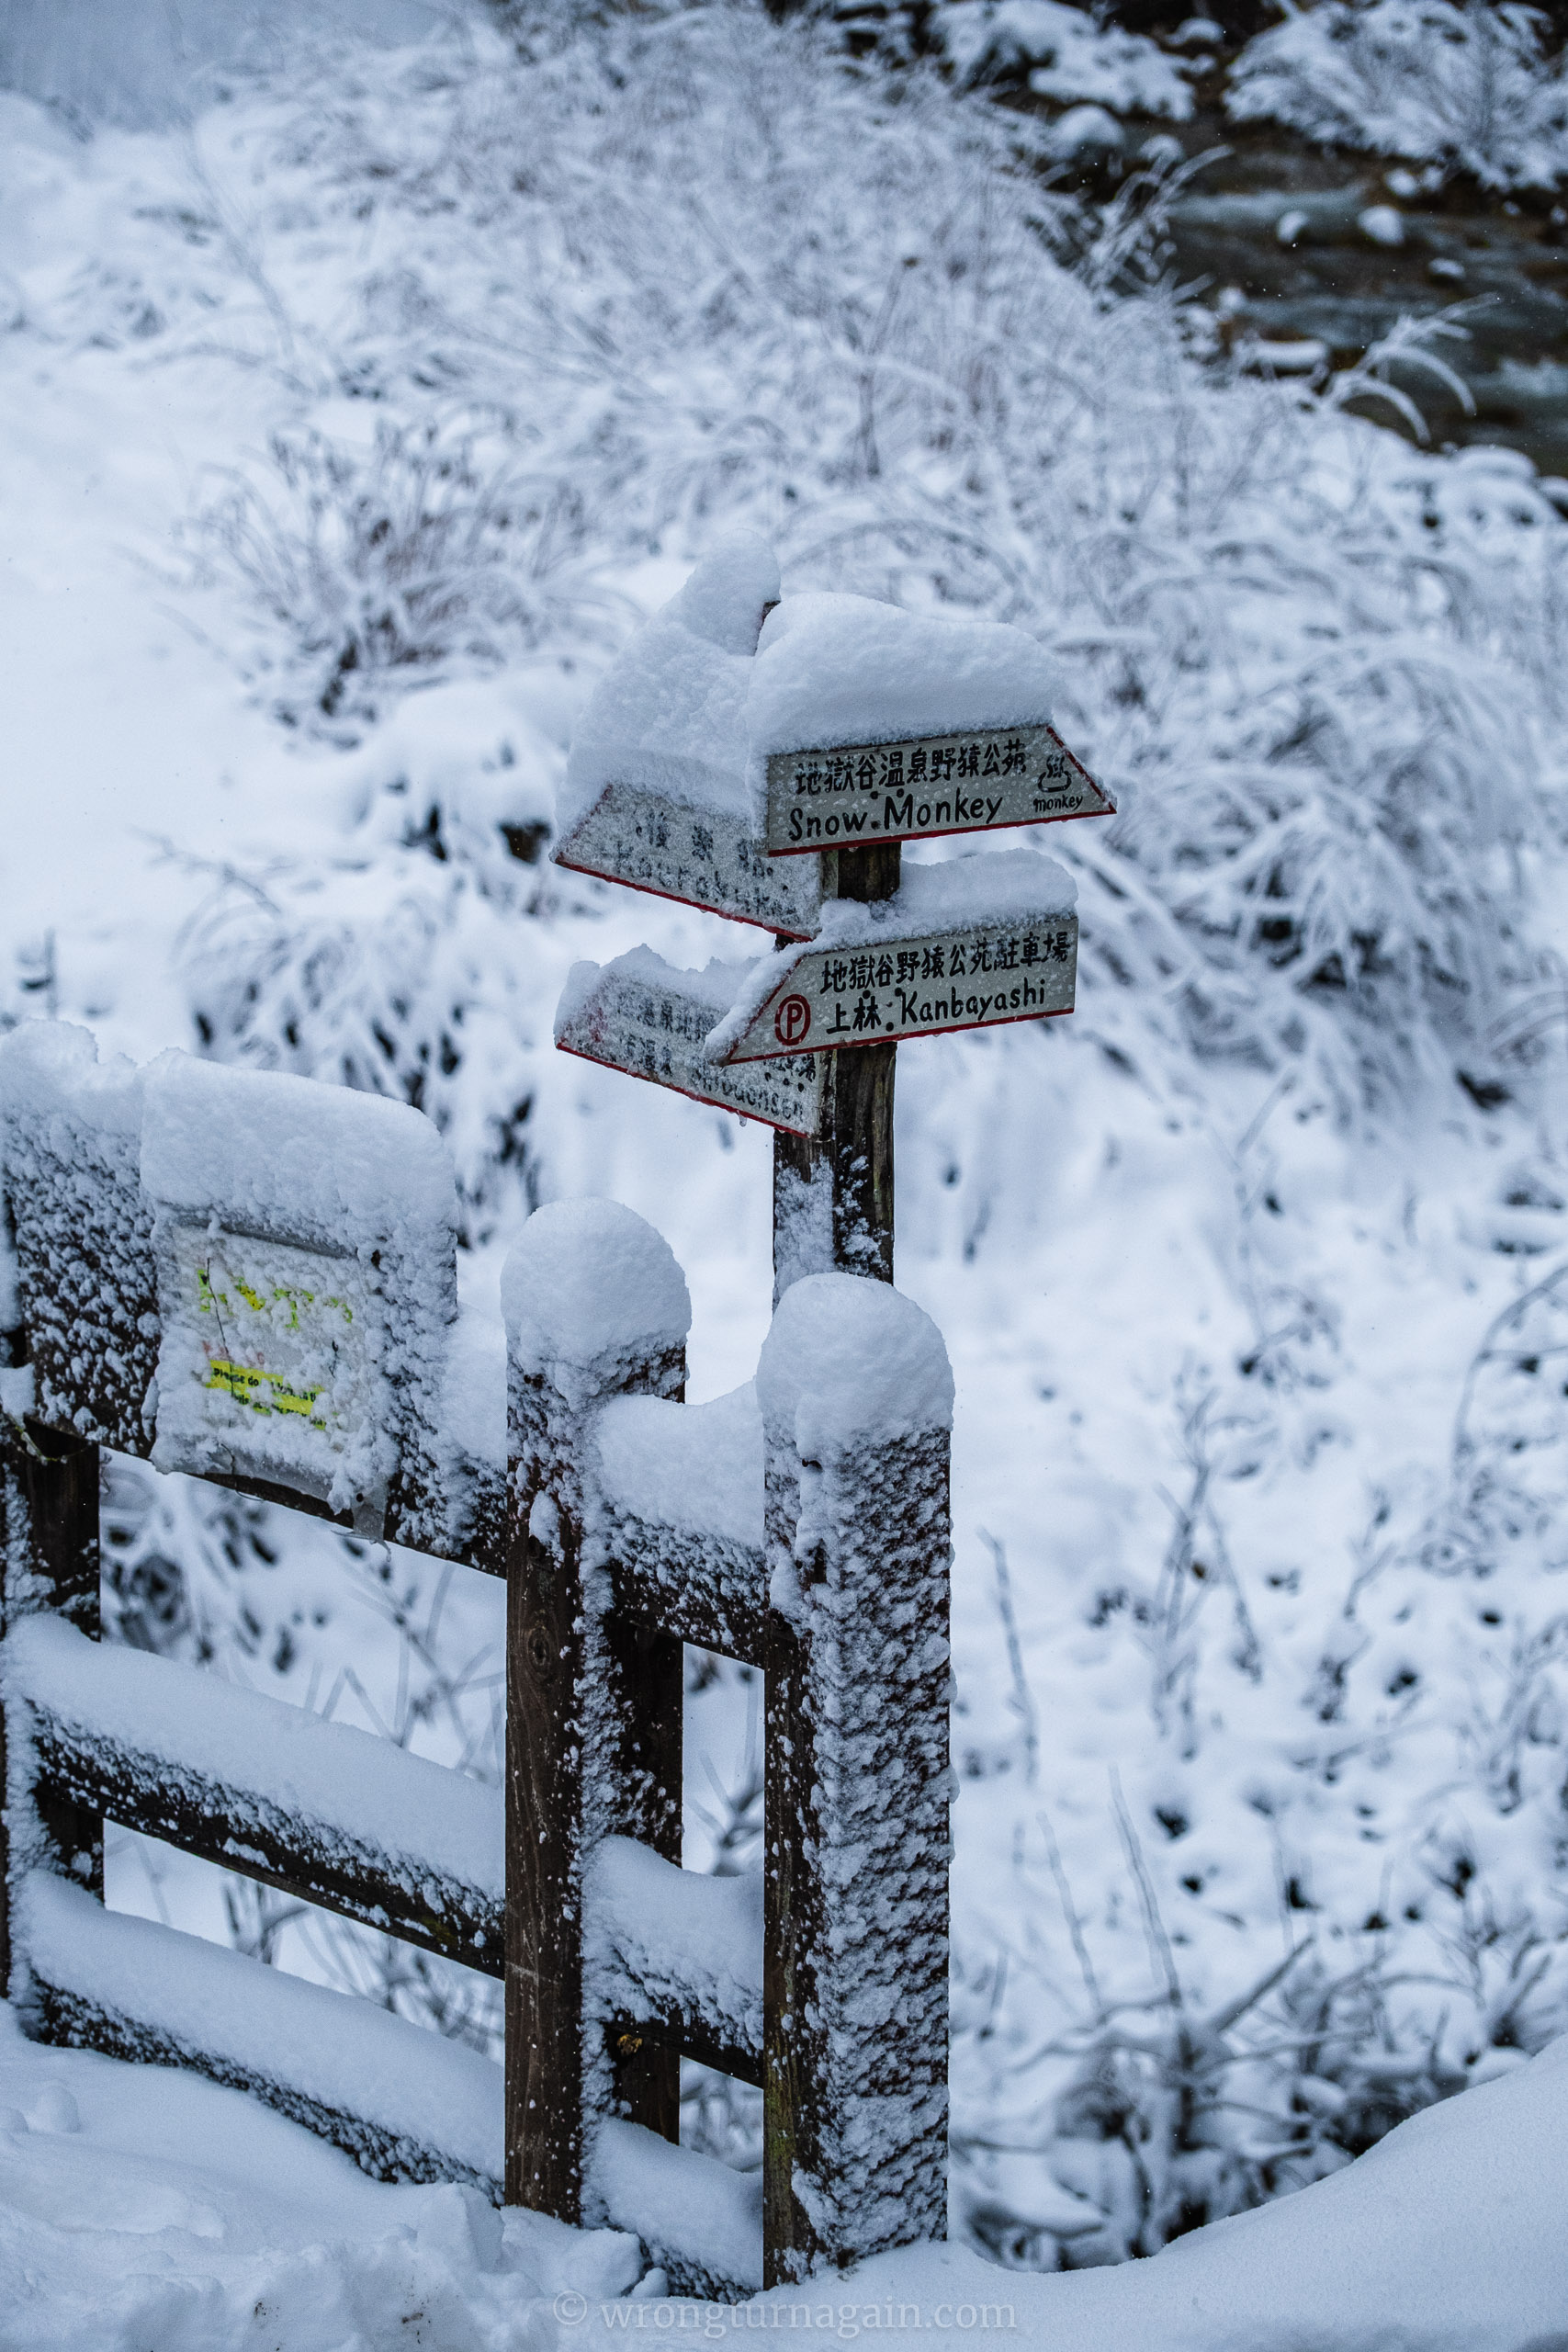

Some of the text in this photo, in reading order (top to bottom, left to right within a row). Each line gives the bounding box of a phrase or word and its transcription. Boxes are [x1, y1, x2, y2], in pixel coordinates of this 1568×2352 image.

[788, 787, 1003, 841] Snow Monkey
[1032, 794, 1083, 812] monkey
[827, 995, 882, 1035] 上林
[900, 978, 1046, 1024] Kanbayashi
